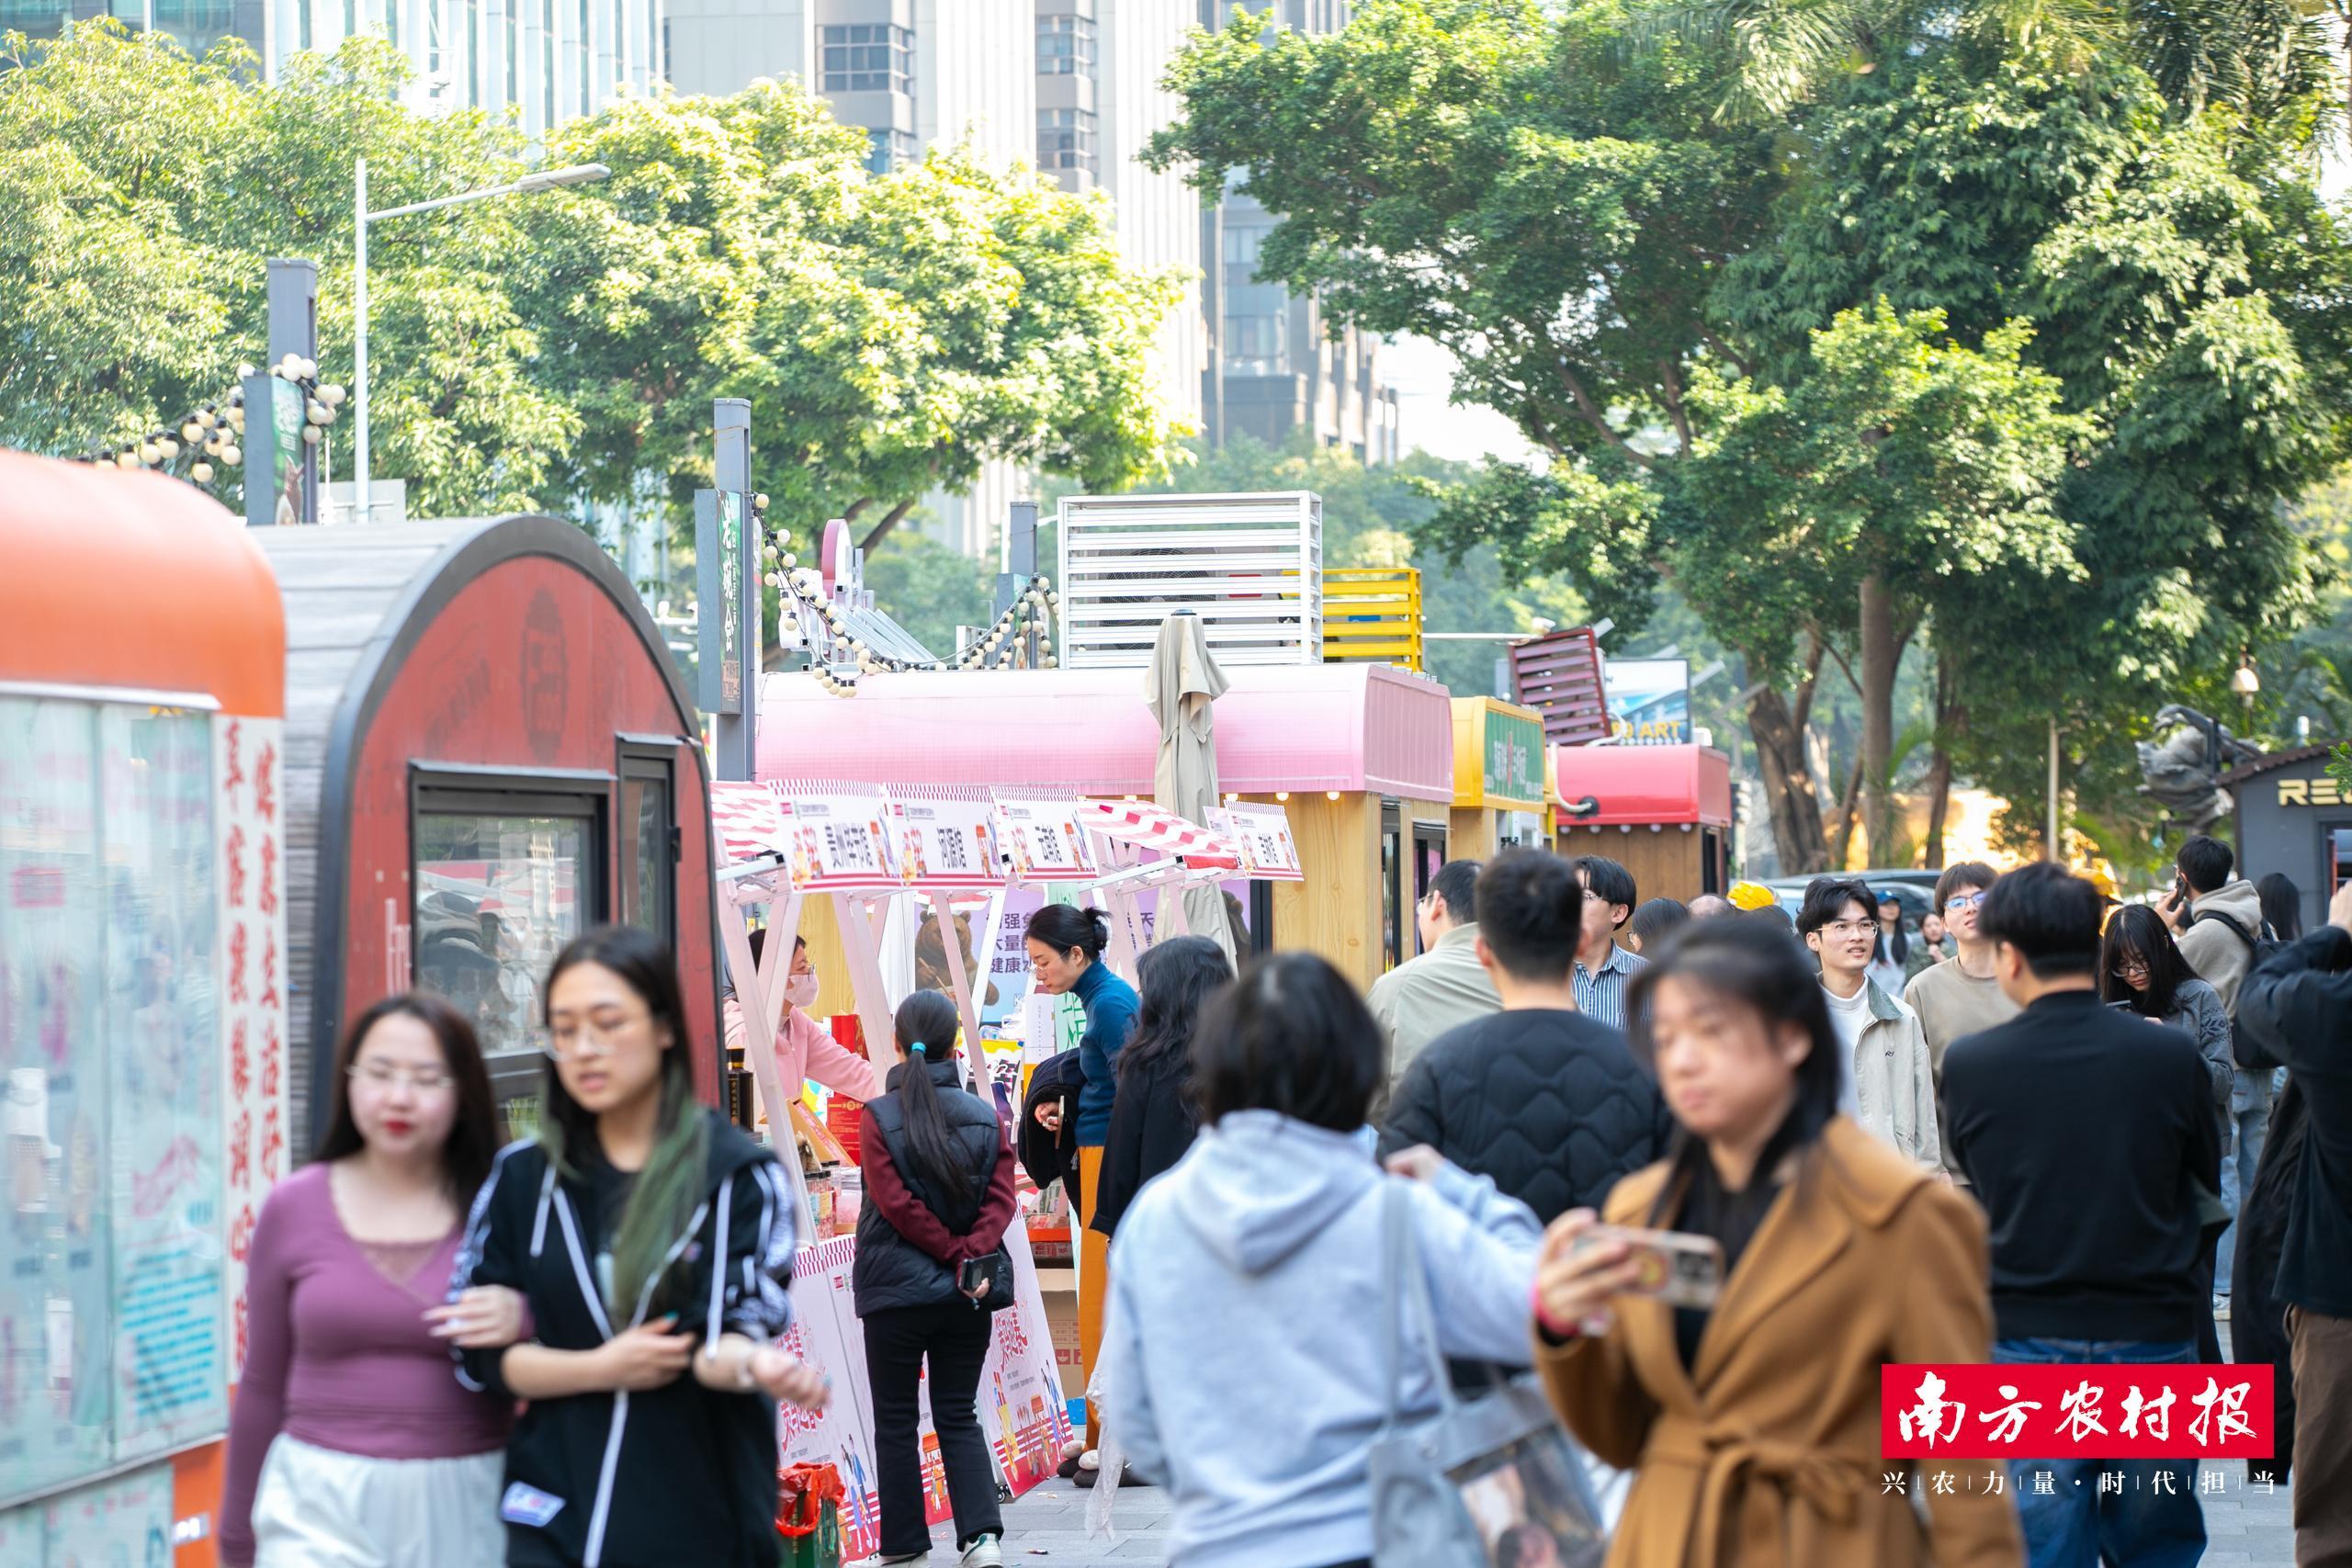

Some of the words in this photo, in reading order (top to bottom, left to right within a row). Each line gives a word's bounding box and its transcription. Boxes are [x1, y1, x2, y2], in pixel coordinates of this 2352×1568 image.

[1639, 720, 1680, 739] ART
[825, 822, 874, 869] 贵州毕节馆
[936, 827, 967, 869] 河源馆
[1035, 824, 1063, 863] 云南馆
